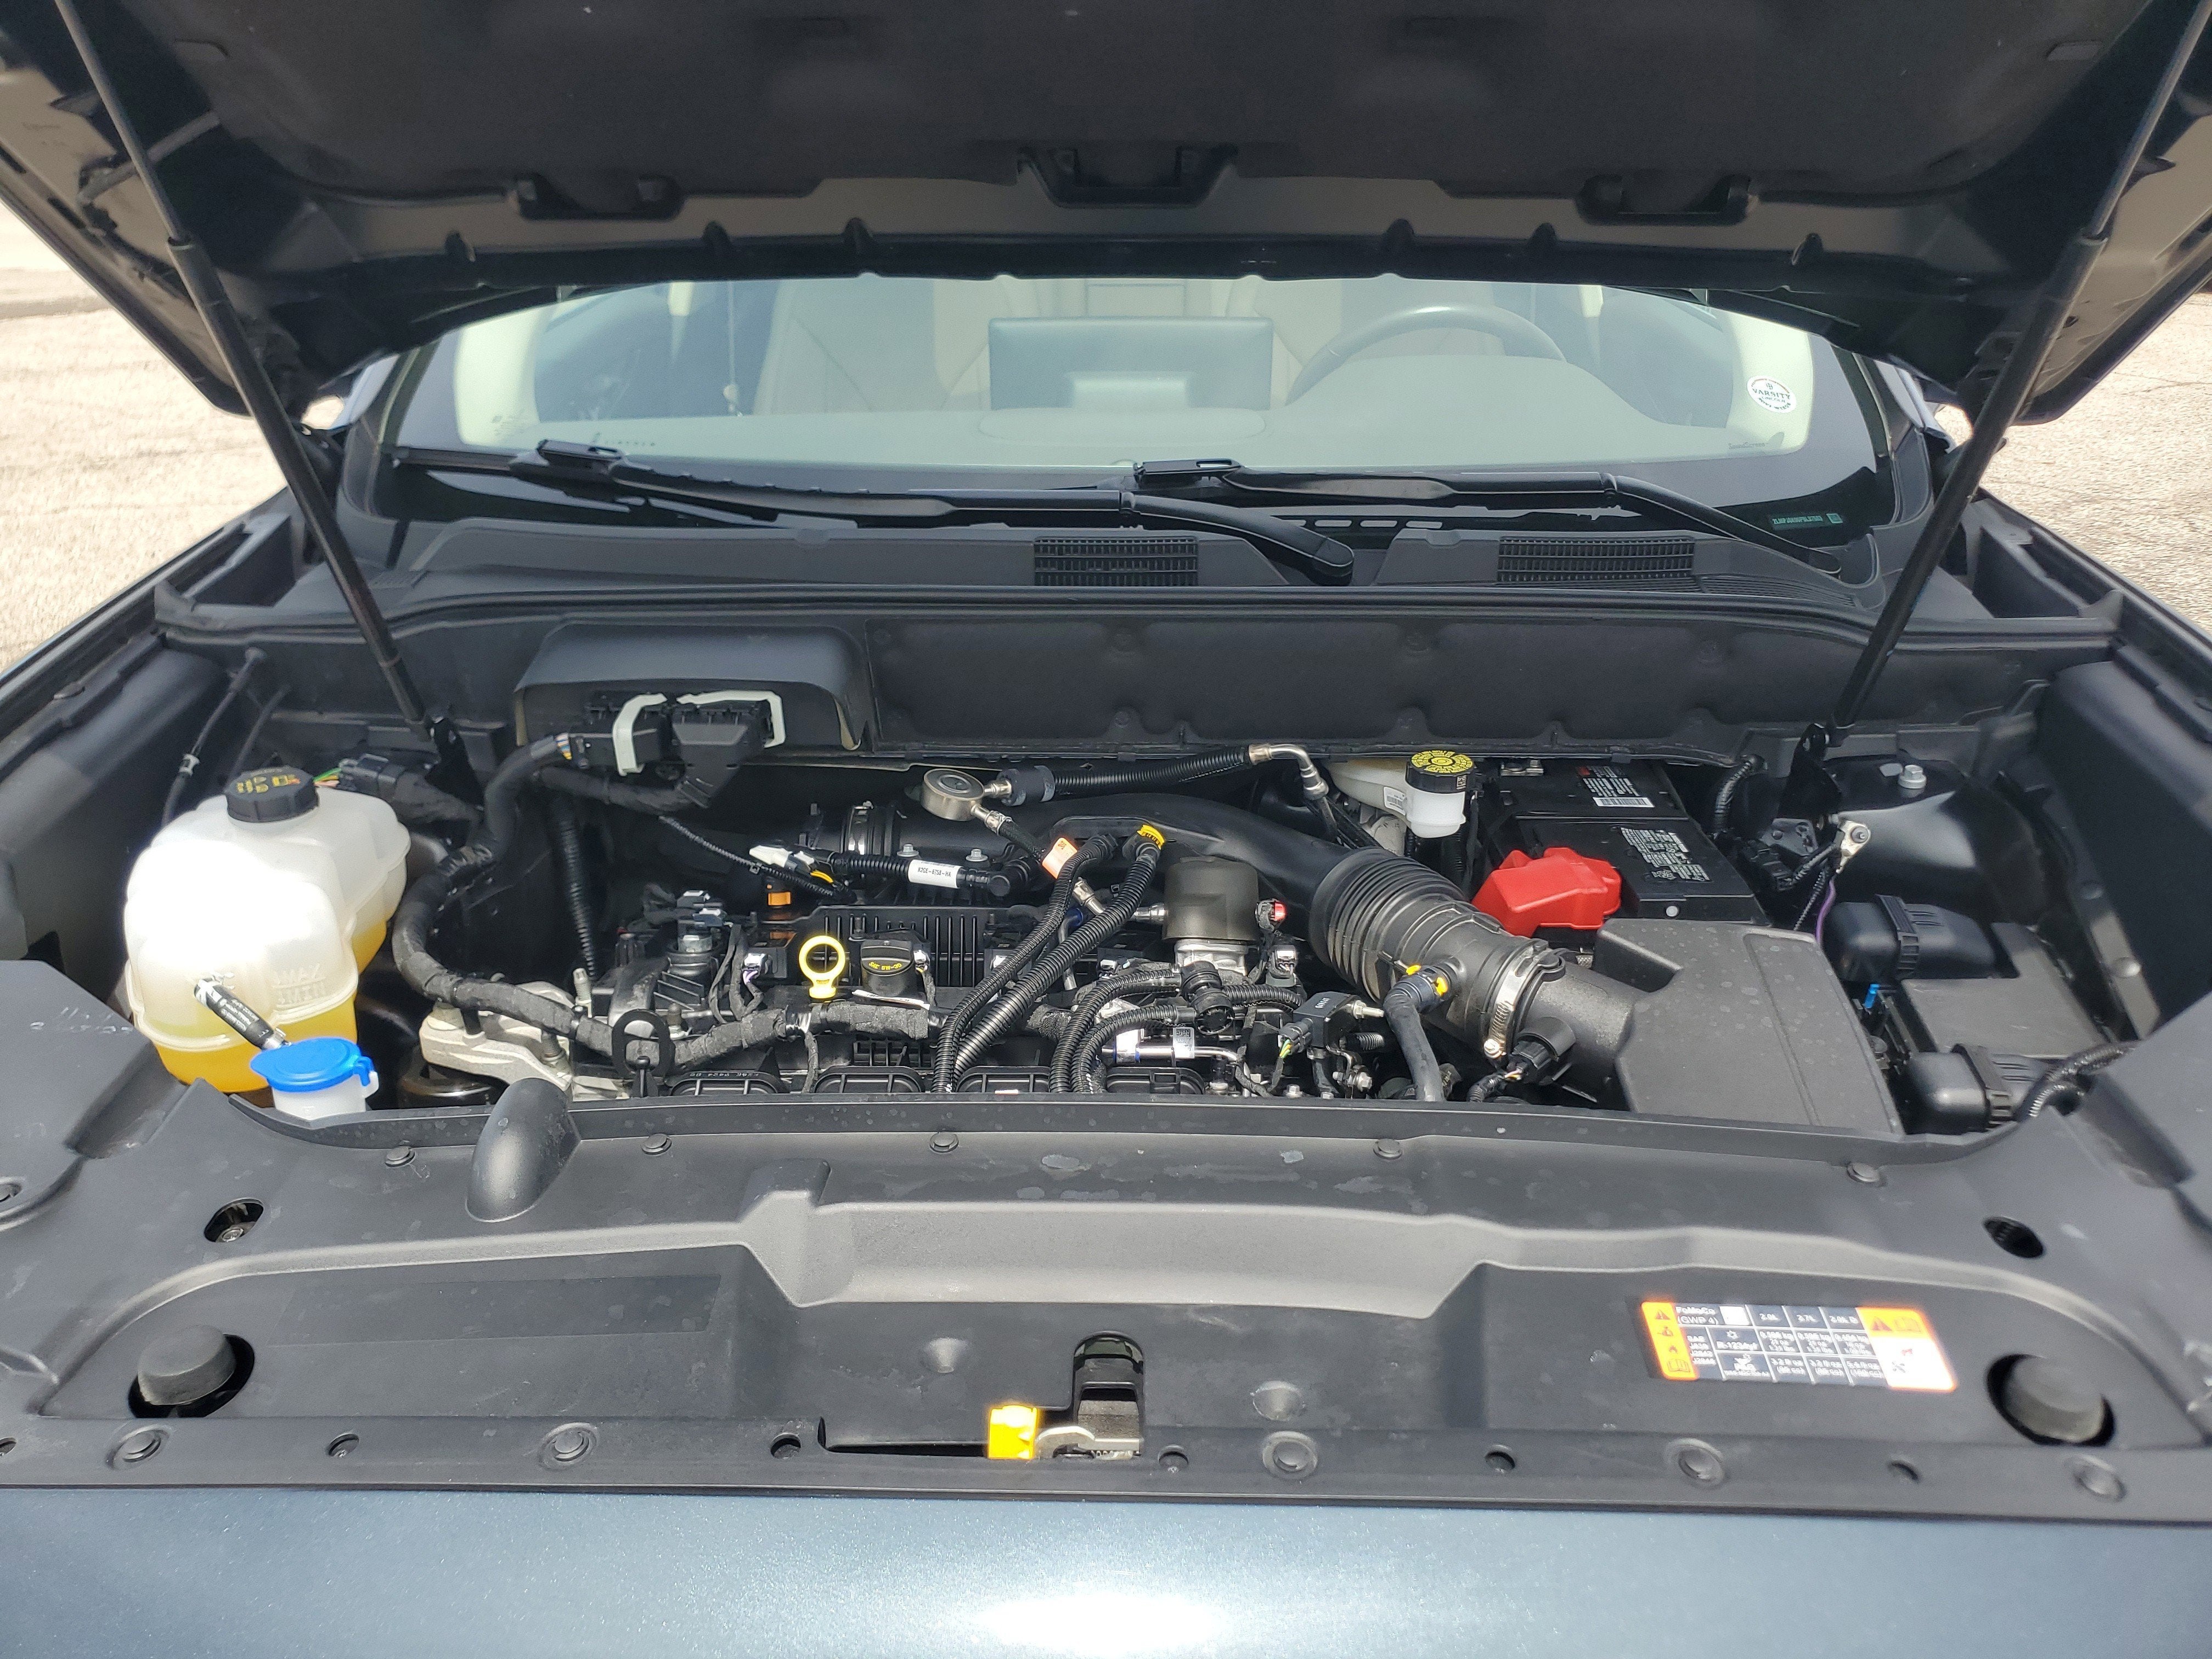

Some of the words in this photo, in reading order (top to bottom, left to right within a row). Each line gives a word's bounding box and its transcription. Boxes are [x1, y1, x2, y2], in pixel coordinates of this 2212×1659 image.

[1752, 388, 1790, 400] VARSITY
[1675, 1306, 1716, 1314] FoMoCo
[1677, 1316, 1707, 1324] (GWP
